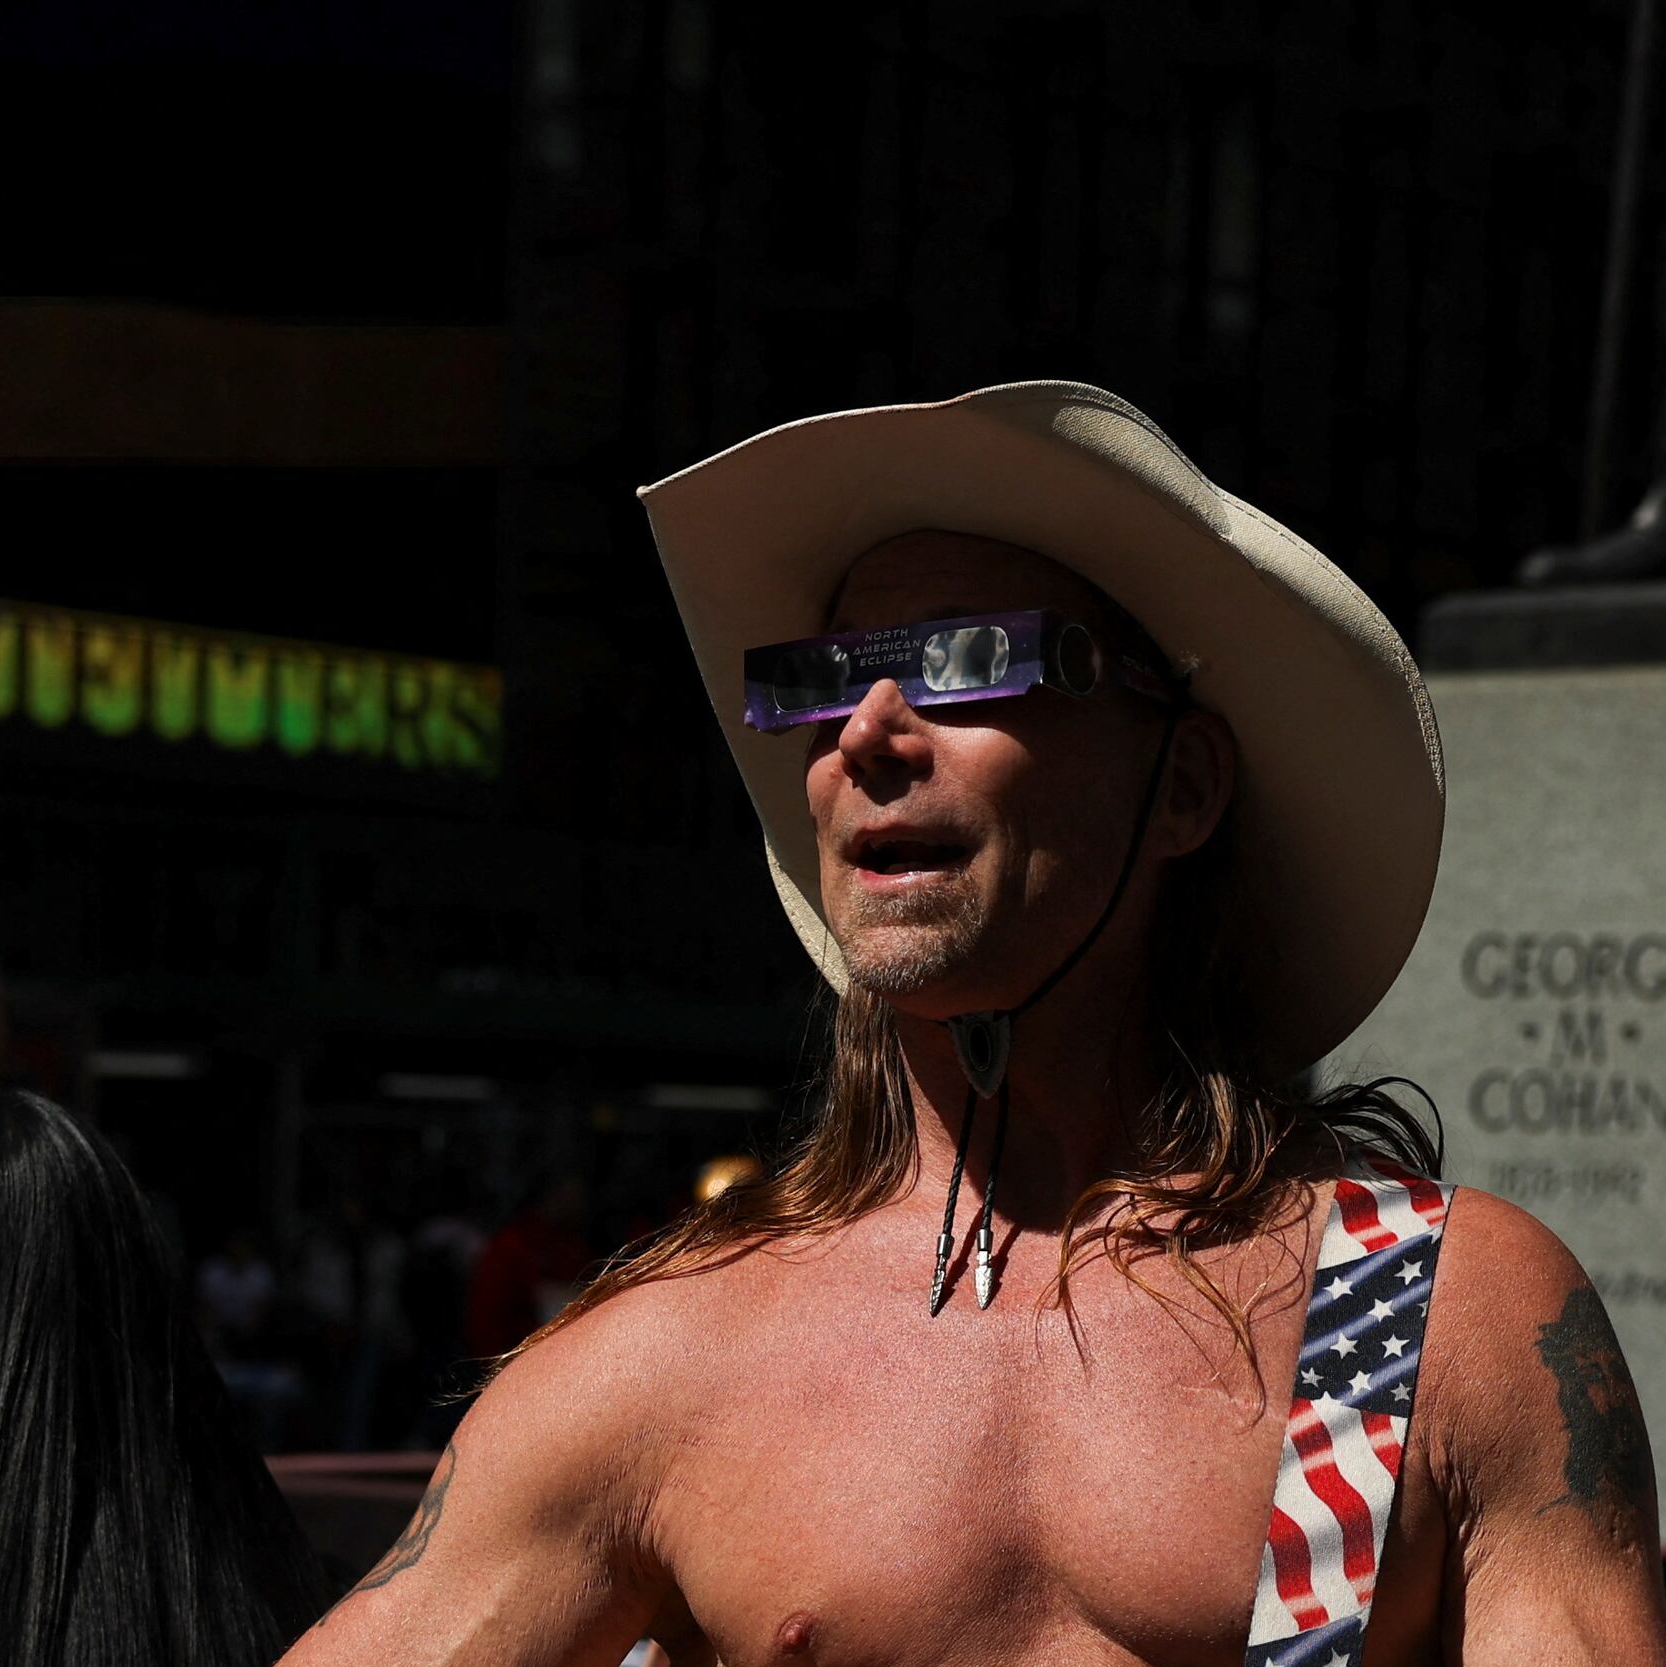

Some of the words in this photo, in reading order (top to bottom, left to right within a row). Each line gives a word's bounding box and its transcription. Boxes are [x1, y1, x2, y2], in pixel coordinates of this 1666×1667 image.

[865, 627, 909, 642] NORTH
[852, 639, 921, 656] AMERICAN
[859, 652, 913, 667] ECLIPSE
